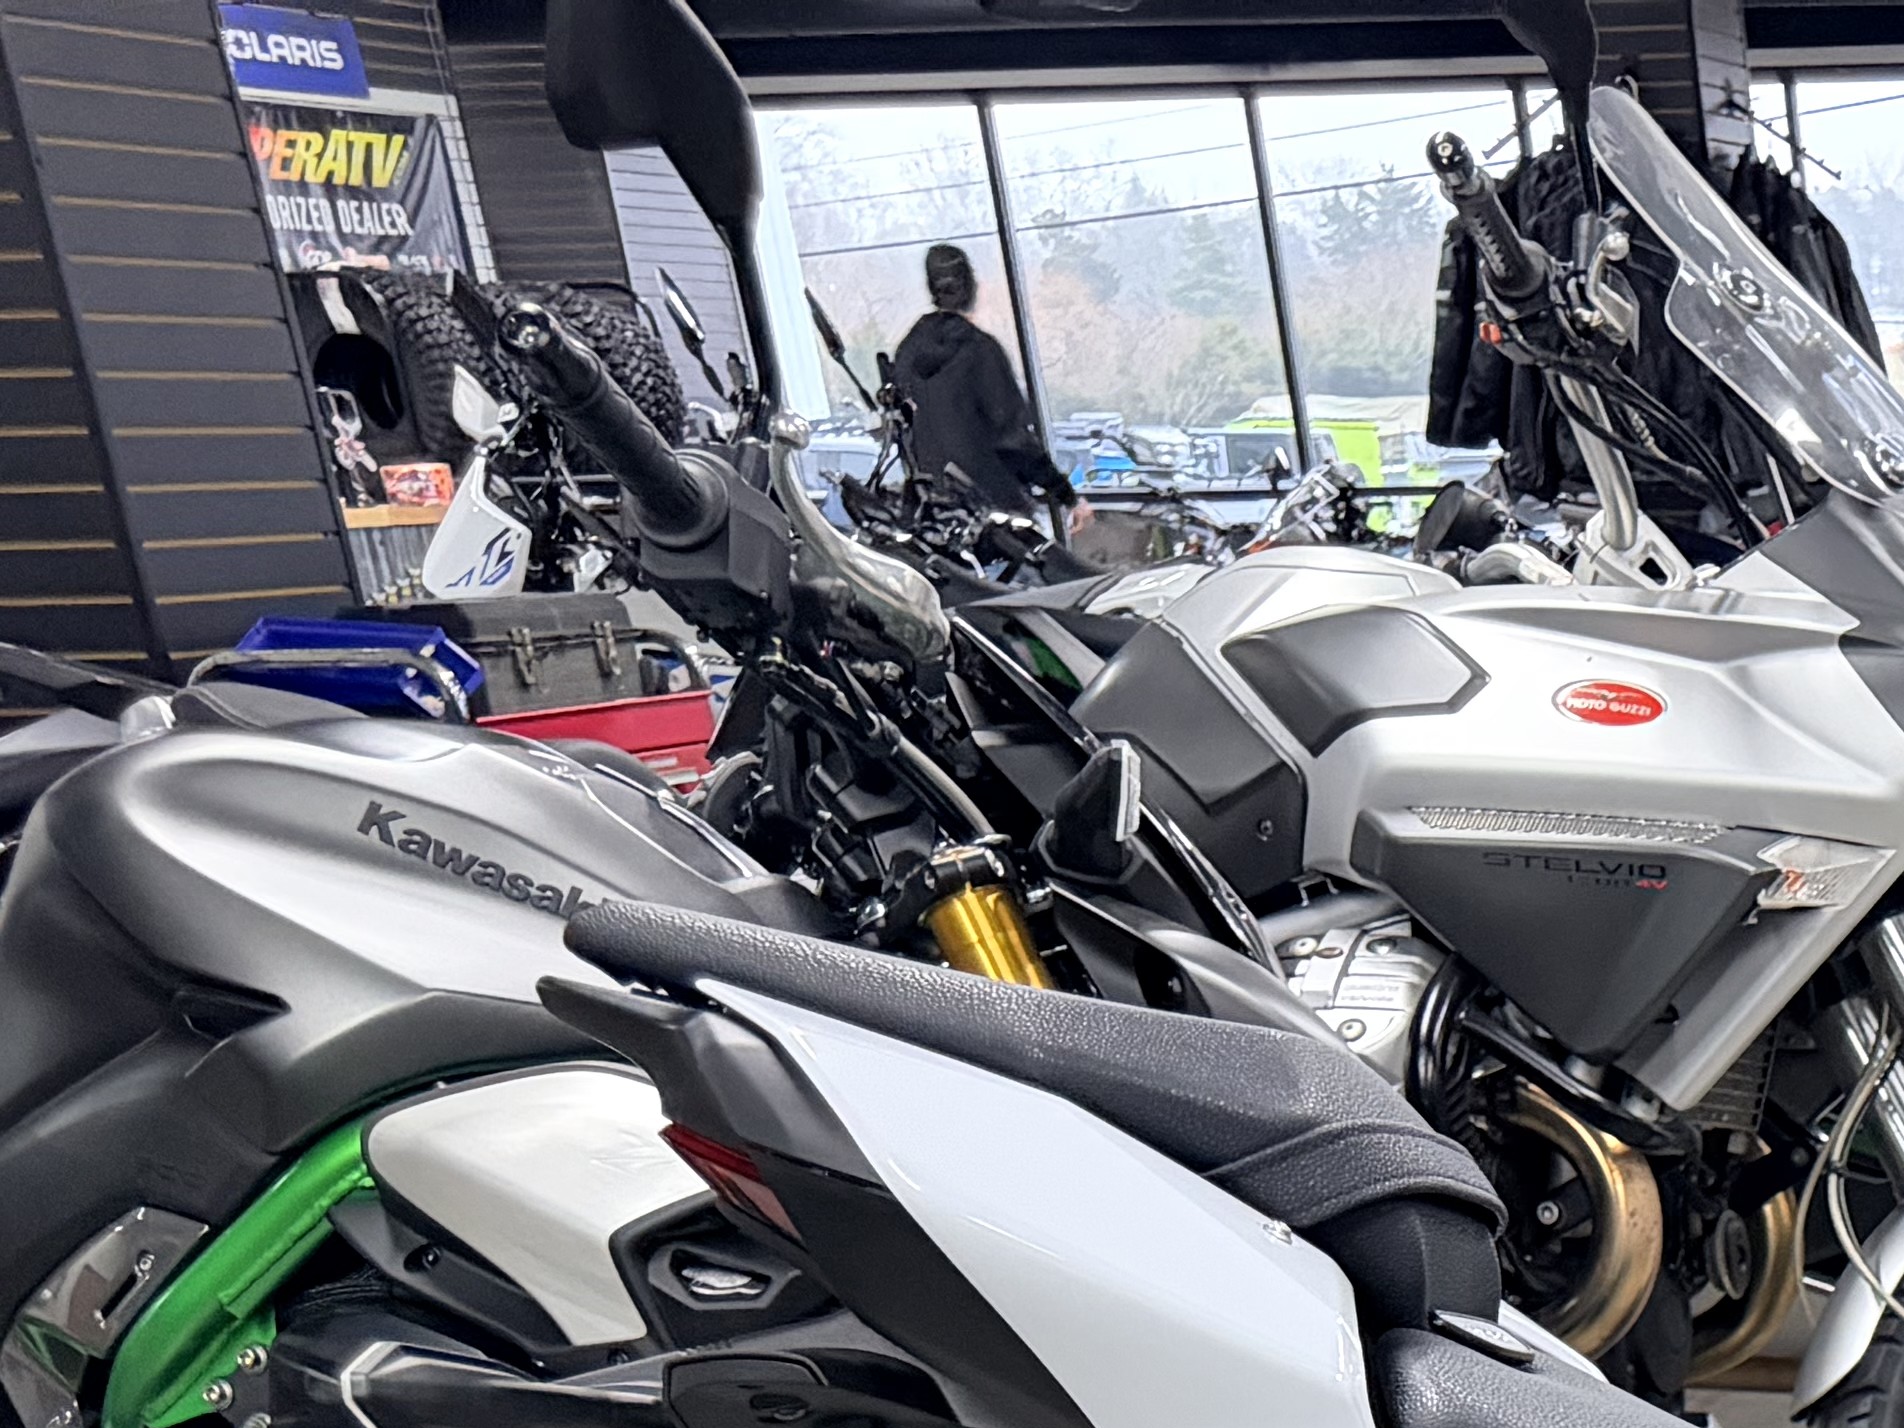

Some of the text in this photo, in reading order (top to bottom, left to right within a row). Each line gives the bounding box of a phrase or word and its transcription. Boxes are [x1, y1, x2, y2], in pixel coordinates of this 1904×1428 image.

[221, 28, 344, 71] OLARIS
[337, 199, 413, 236] DEALER
[1566, 697, 1652, 716] MOTO GUZZI
[357, 800, 607, 920] Kawasak
[1483, 852, 1667, 880] STELVIO
